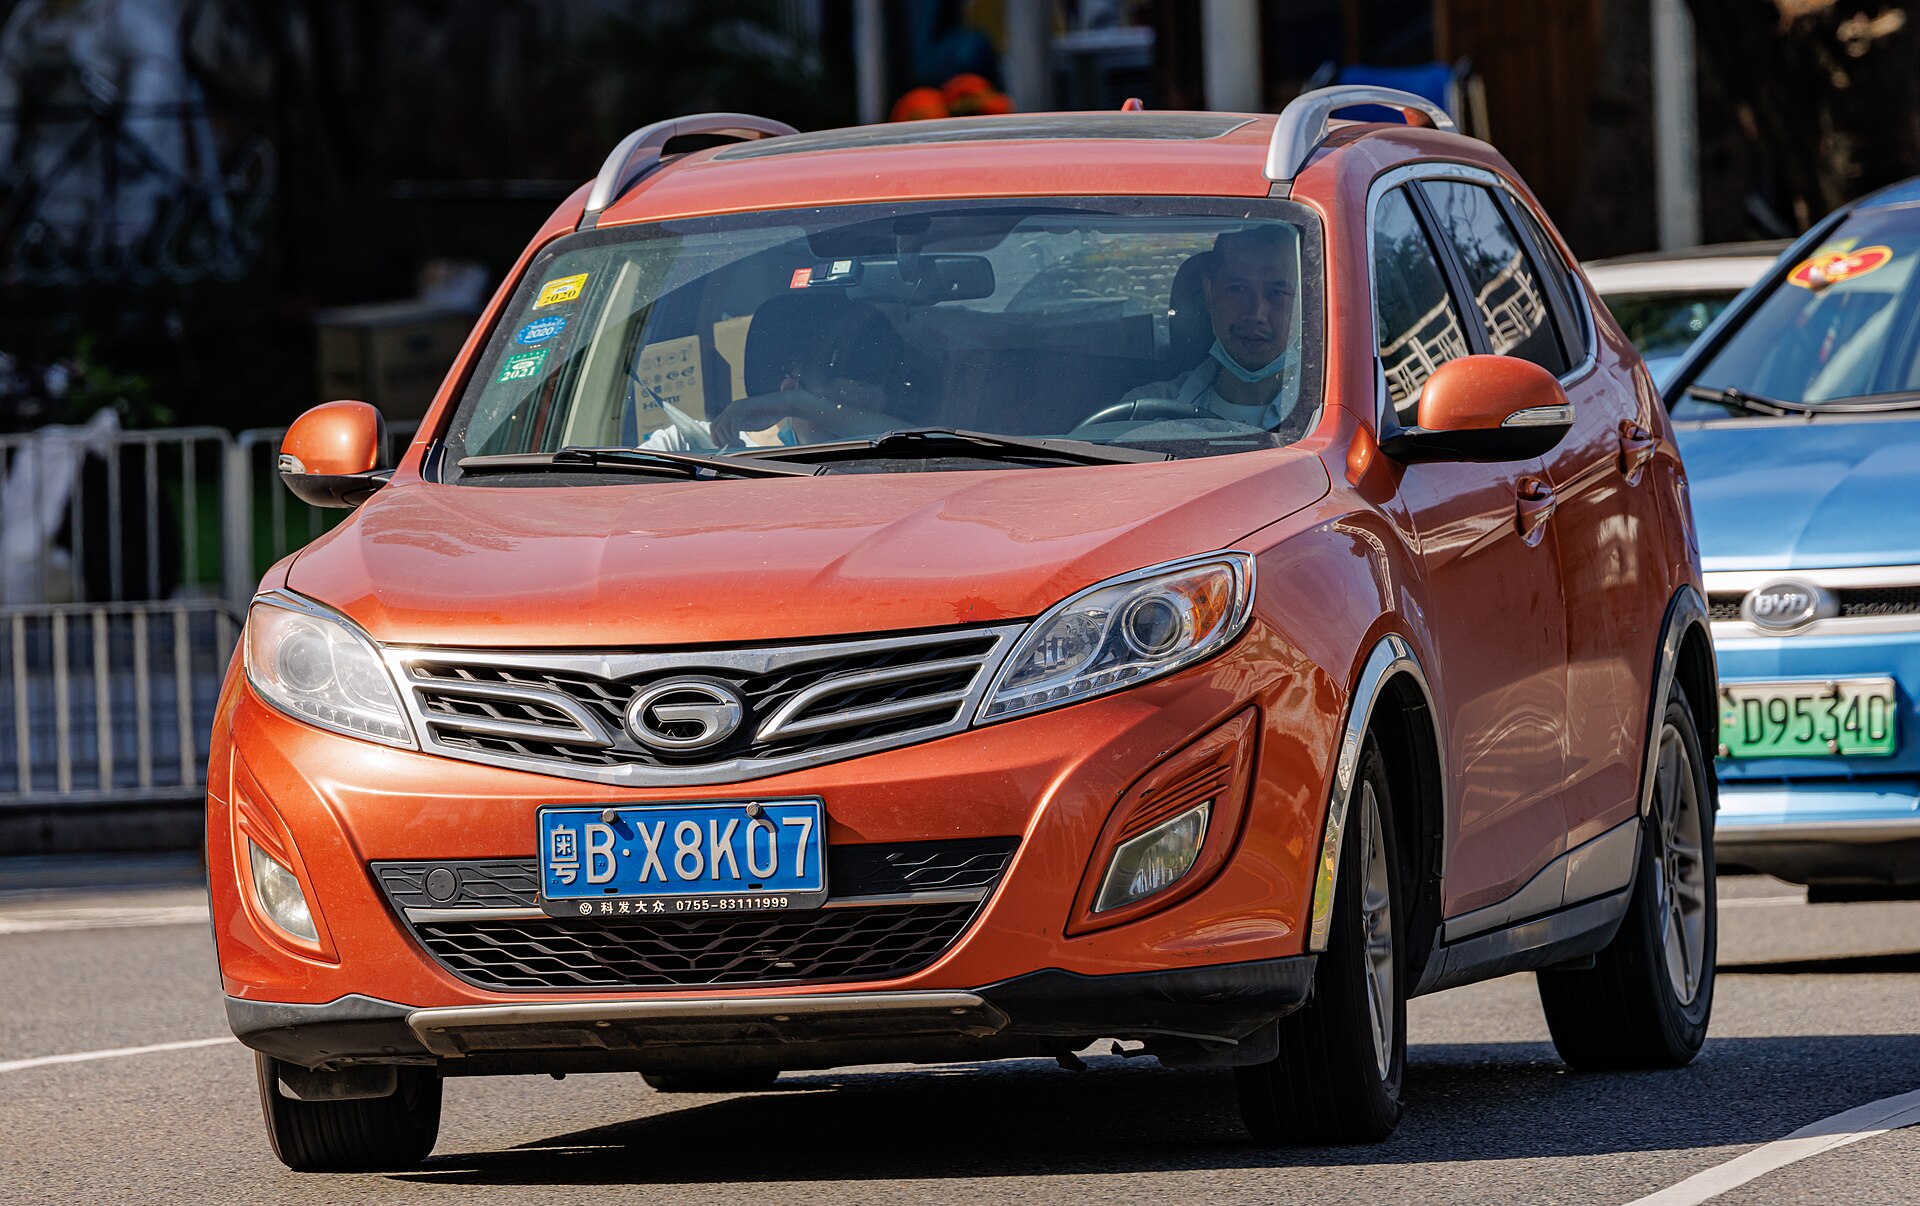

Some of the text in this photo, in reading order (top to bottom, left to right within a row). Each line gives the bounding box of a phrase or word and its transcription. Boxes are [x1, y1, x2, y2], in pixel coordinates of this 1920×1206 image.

[543, 290, 577, 304] 2020
[524, 327, 555, 340] 2020
[500, 366, 536, 381] 2021
[1754, 593, 1808, 616] BYD
[1742, 694, 1888, 746] D95340
[600, 899, 667, 915] 科发大众
[676, 897, 789, 912] 0755-83111999
